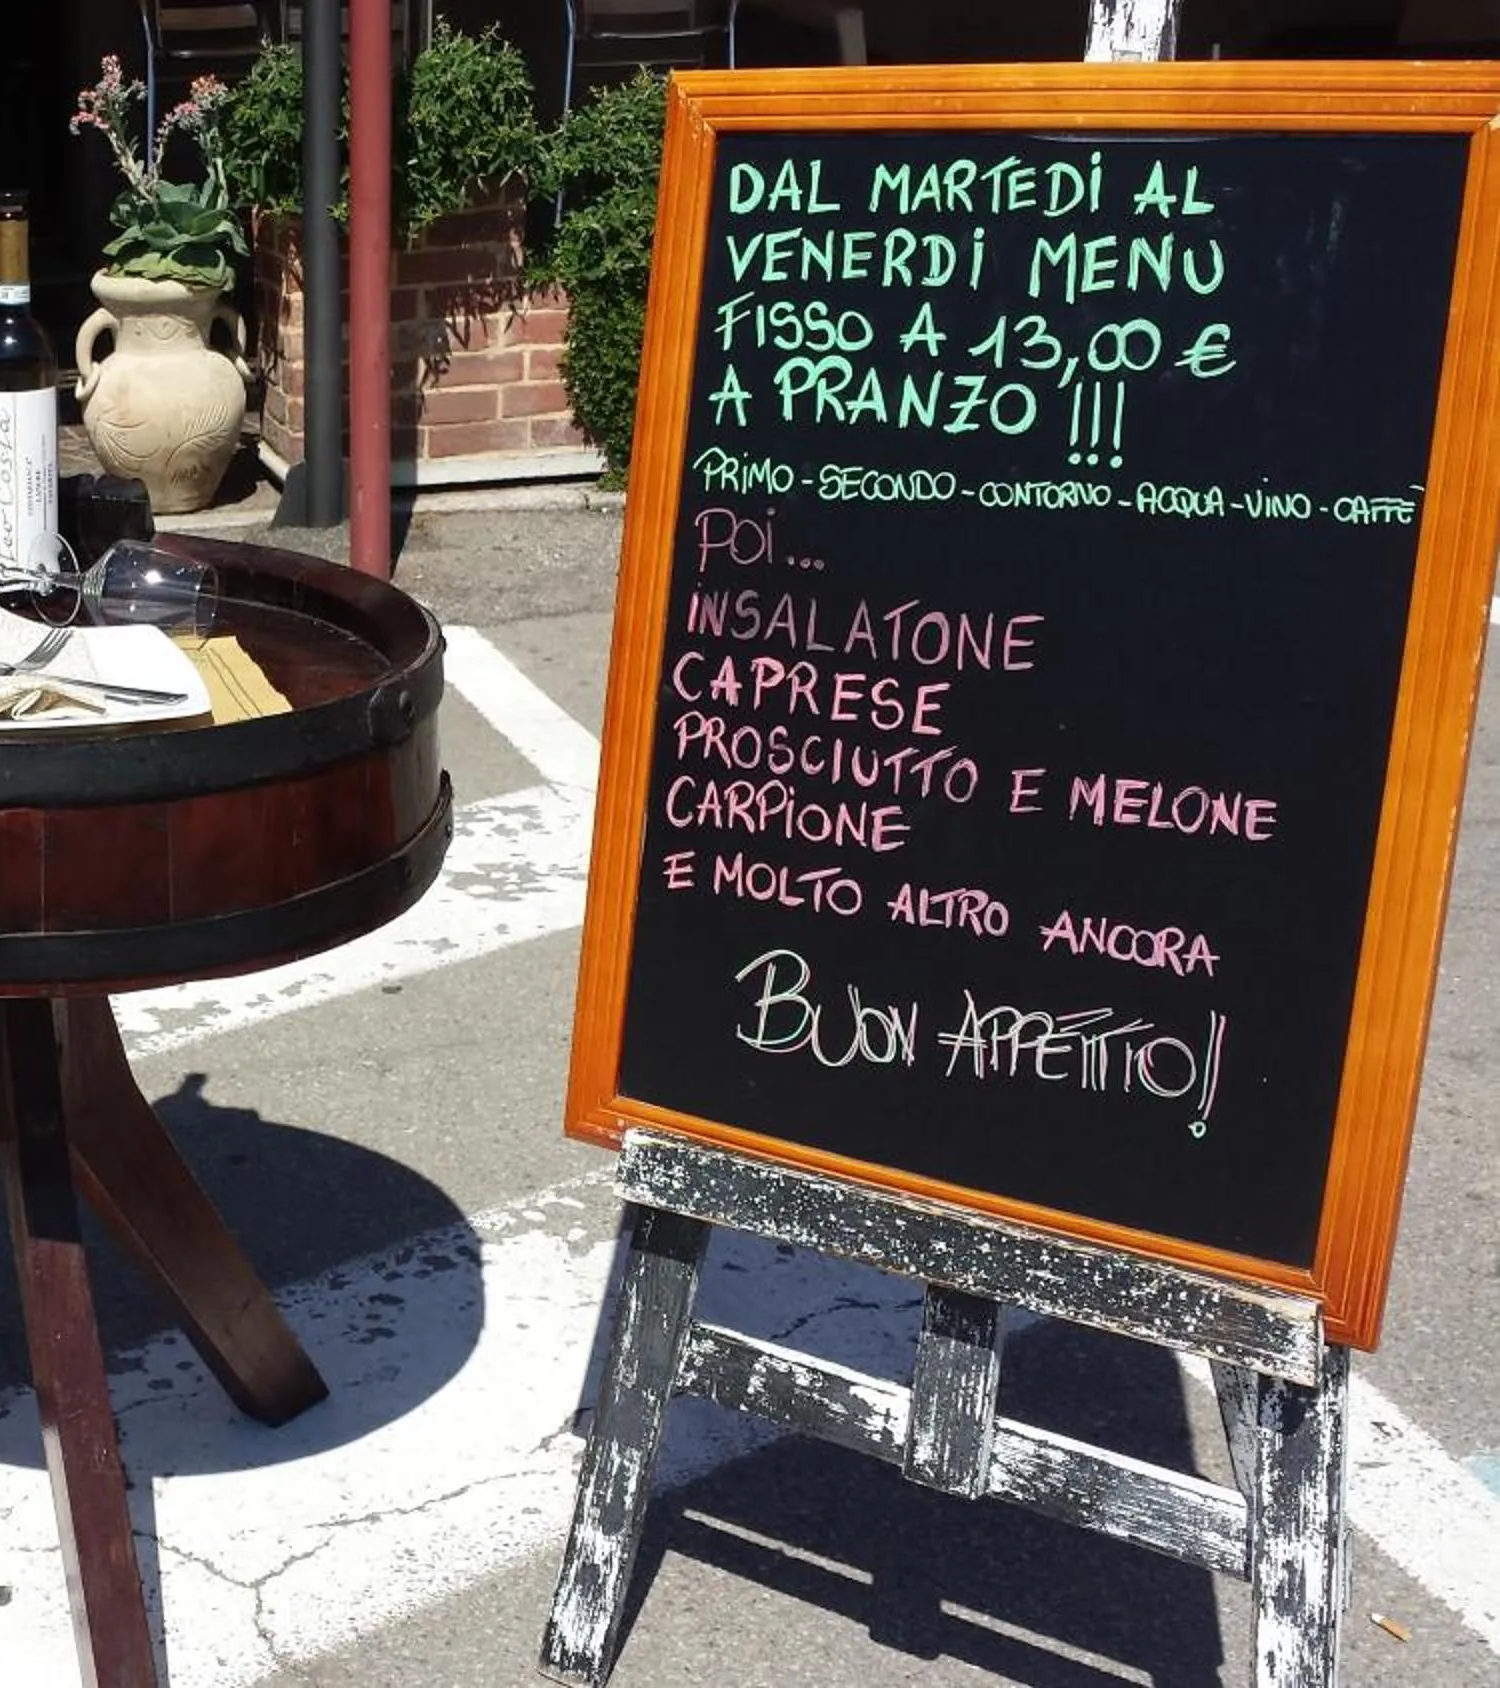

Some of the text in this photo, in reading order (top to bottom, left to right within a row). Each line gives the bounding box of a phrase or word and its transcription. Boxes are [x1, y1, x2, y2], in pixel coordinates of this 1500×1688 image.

[727, 158, 842, 214] DAL
[1133, 159, 1217, 218] AL
[1027, 231, 1226, 303] MENU
[714, 291, 875, 353] FISSO
[899, 301, 947, 357] A
[968, 314, 1162, 390] 13,00
[708, 363, 753, 427] A
[672, 650, 951, 737] CAPRESE
[673, 710, 1278, 842] PROSCIUTTO E MELONE
[662, 851, 1221, 978] E MOLTO ALTRO ANCORA
